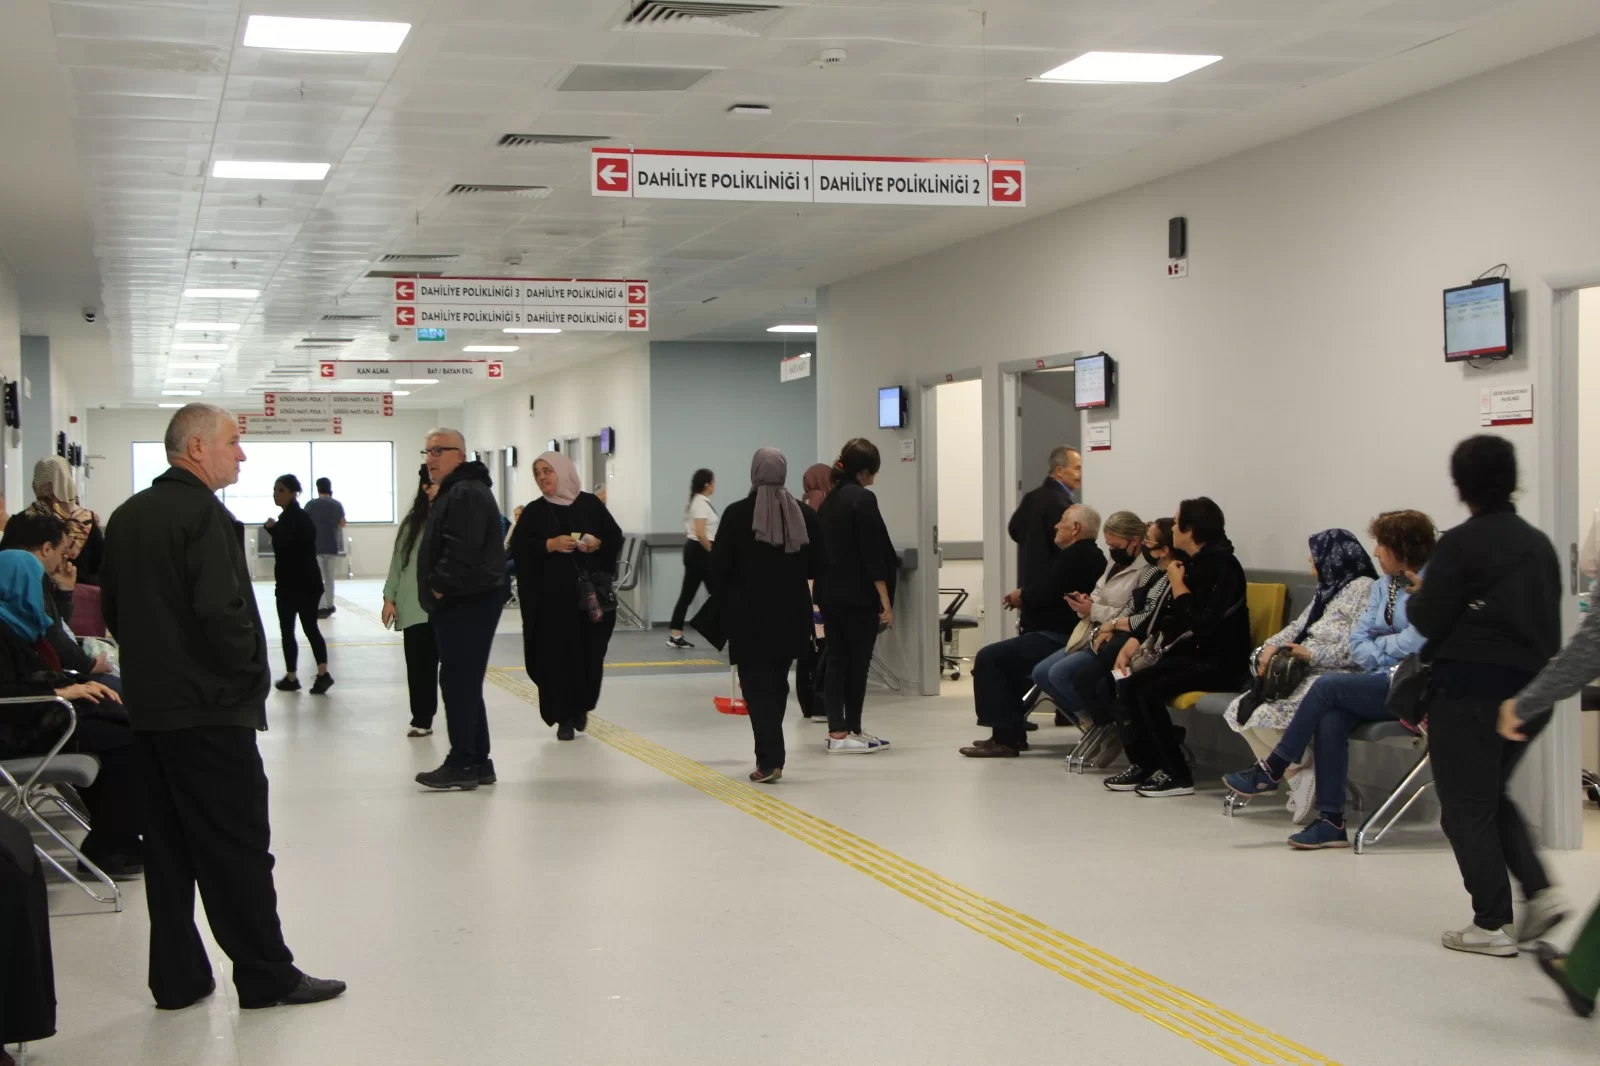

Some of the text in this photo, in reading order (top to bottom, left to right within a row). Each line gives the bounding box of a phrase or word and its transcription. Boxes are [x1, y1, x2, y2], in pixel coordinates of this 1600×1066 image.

[638, 168, 809, 190] DAHİLİYE POLİKLİNİĞİ 1
[820, 172, 980, 194] DAHİLİYE POLİKLİNİĞİ 2
[421, 284, 520, 298] DAHİLİYE POLİKLİNİĞİ 3
[526, 286, 623, 299] DAHİLİYE POLİKLİNİĞİ 4
[421, 309, 520, 322] DAHİLİYE POLİKLİNİĞİ 5
[527, 311, 623, 324] DAHİLİYE POLİKLİNİĞİ 6
